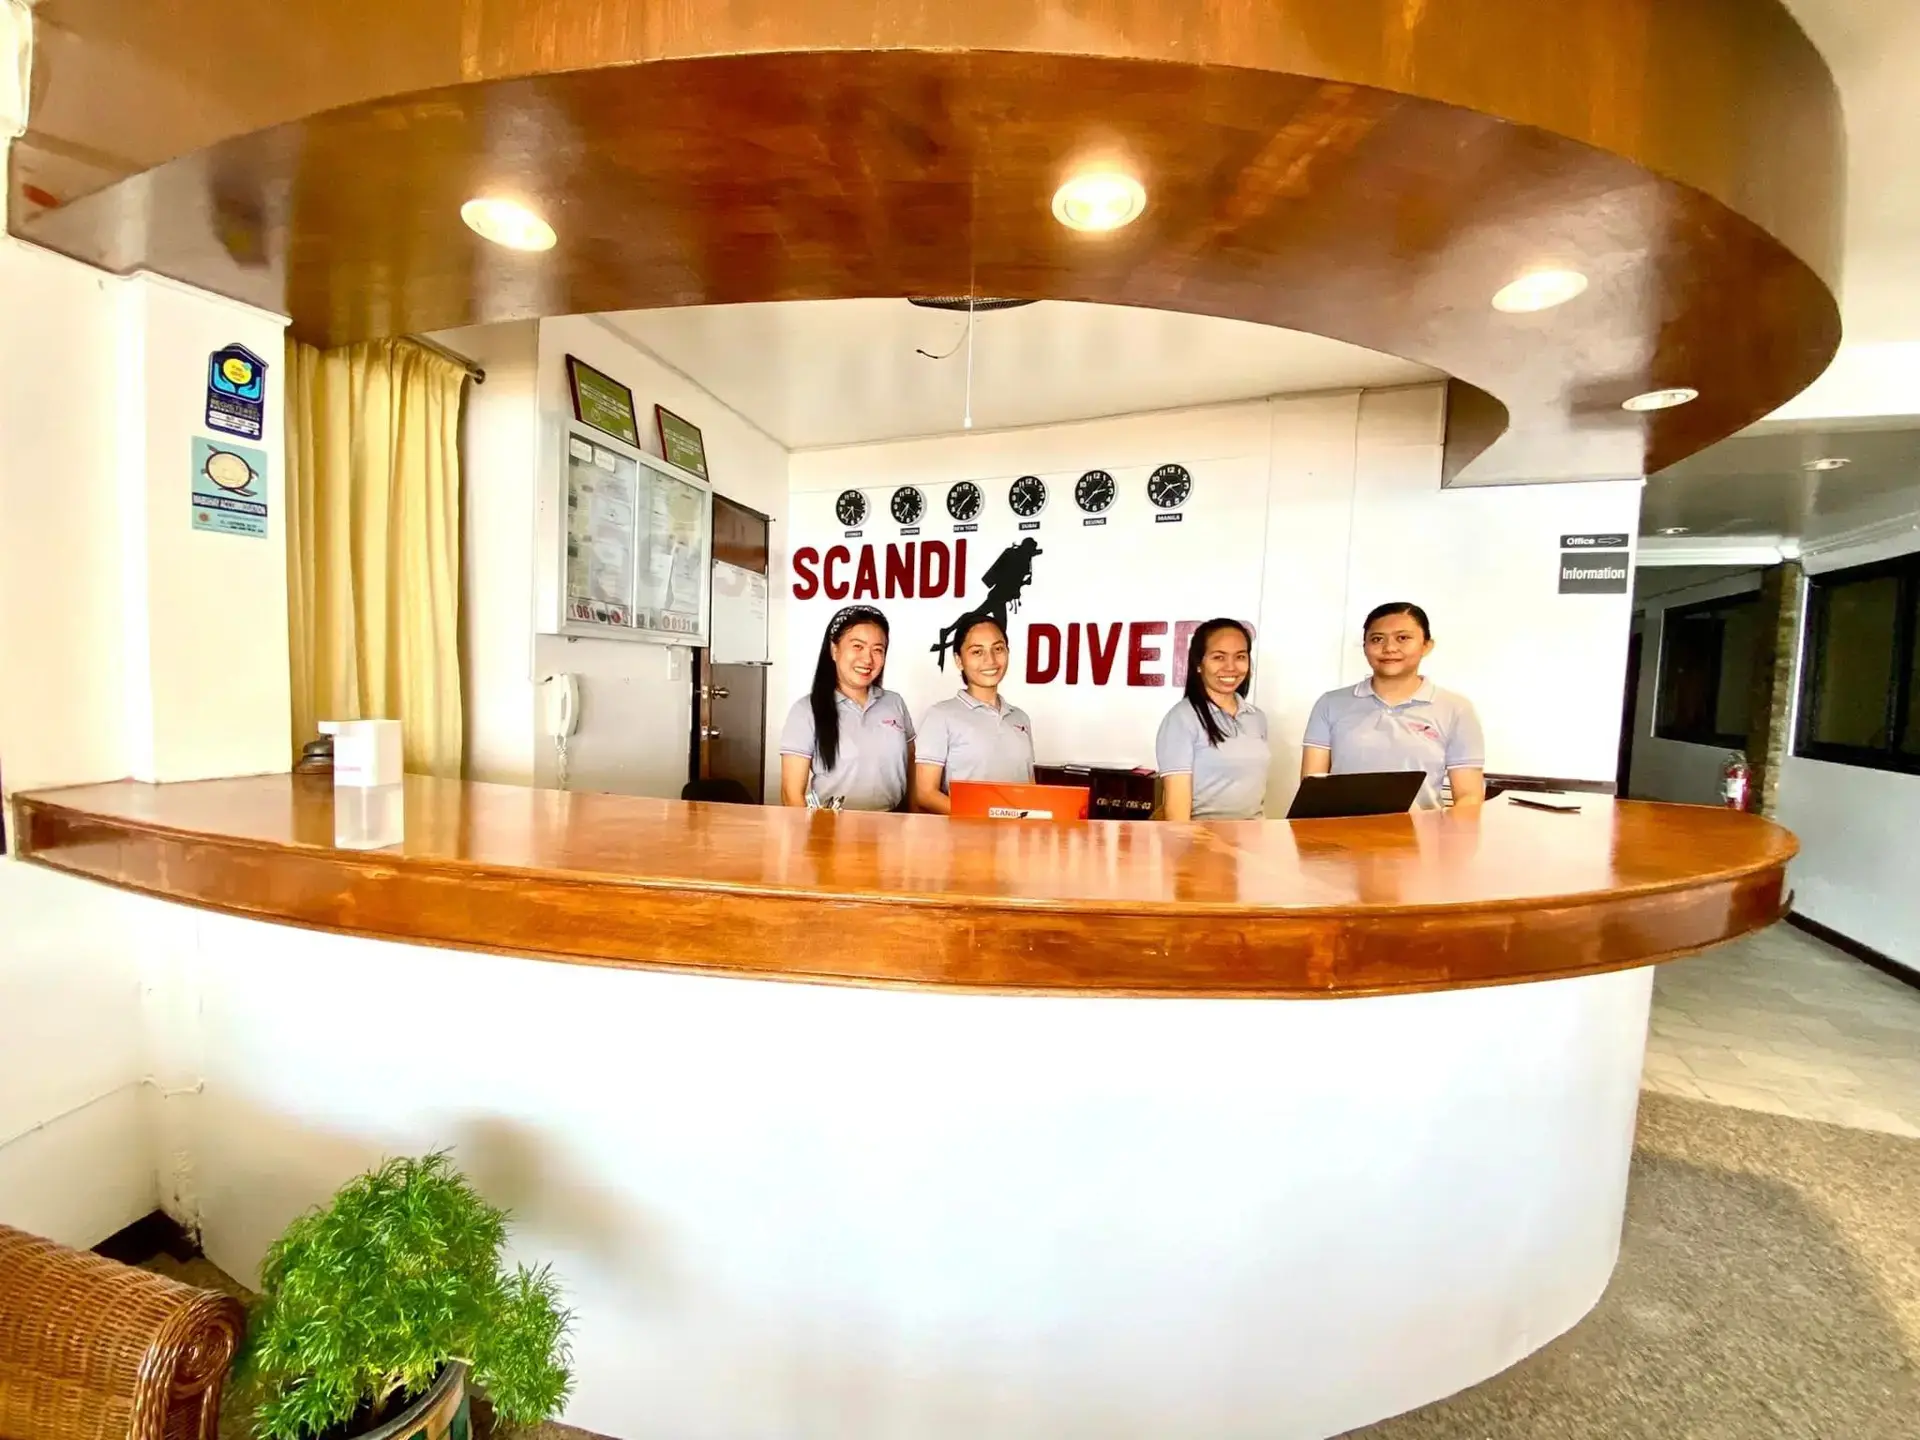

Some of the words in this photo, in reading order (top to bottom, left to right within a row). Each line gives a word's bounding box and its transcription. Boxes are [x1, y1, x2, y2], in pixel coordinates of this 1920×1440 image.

[1566, 537, 1596, 546] Office
[792, 538, 967, 600] SCANDI
[1562, 567, 1626, 580] Information
[1026, 621, 1257, 687] DIVE
